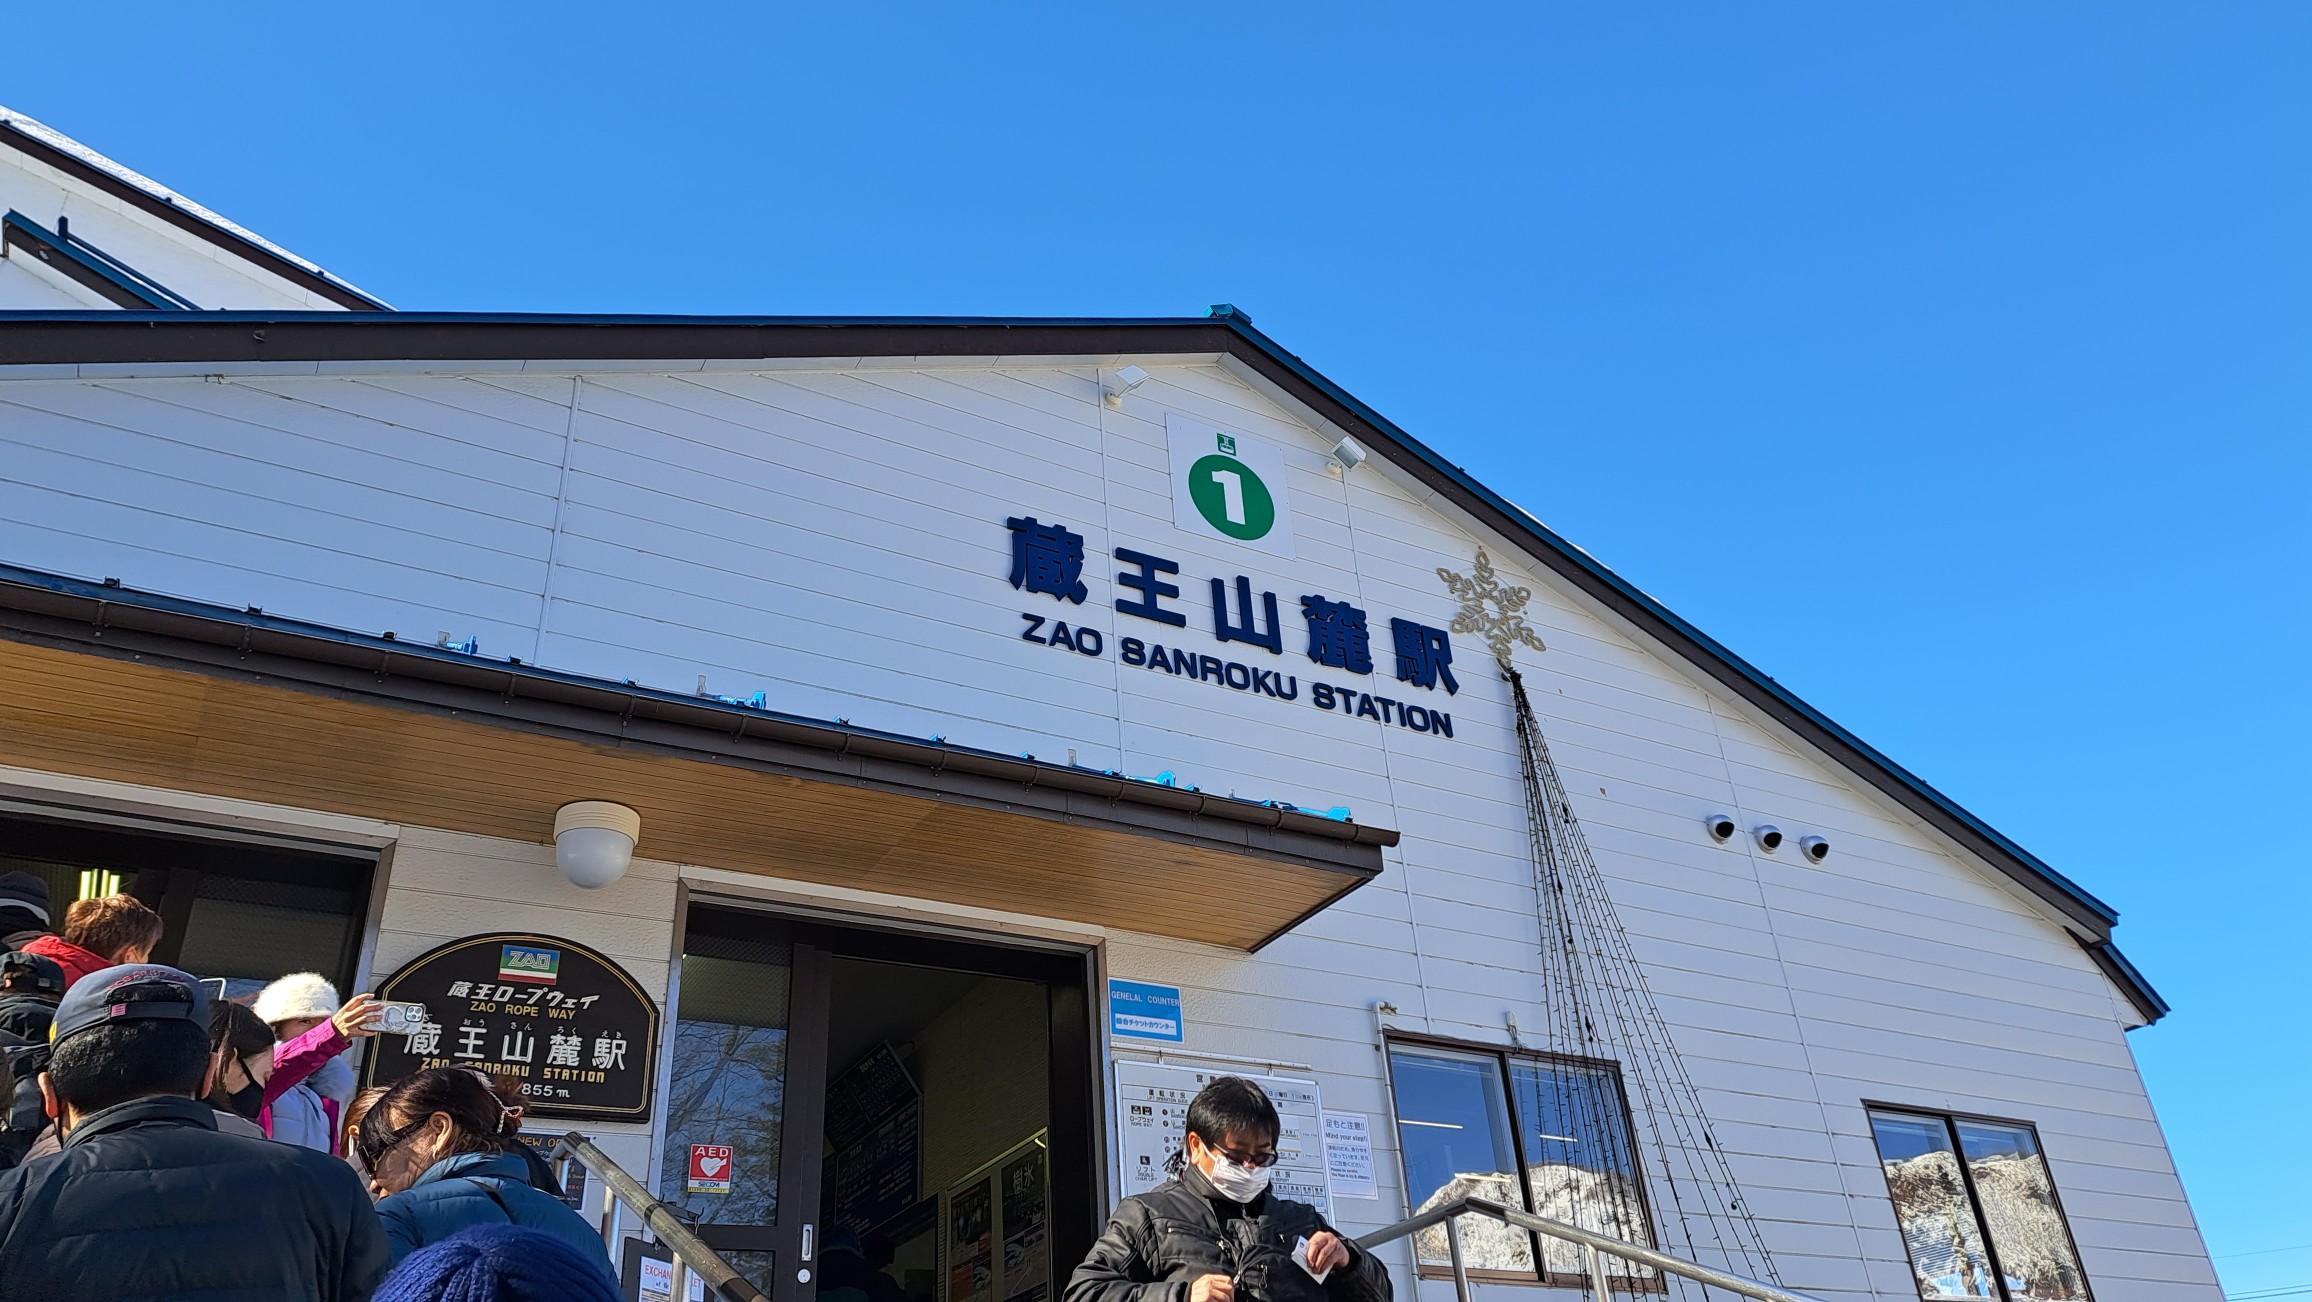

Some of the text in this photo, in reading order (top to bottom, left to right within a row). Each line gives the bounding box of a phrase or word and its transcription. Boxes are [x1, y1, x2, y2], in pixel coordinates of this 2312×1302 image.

[1211, 471, 1247, 525] 1
[1006, 515, 1459, 696] 蔵王山麓駅
[1022, 612, 1454, 738] ZAO SANROKU STATION
[507, 950, 551, 970] ZAO
[447, 980, 600, 1010] 蔵王ロープウェイ
[1111, 991, 1180, 1007] GENELAL COUNTER
[470, 1001, 576, 1020] ZAO ROPE WAY
[403, 1021, 627, 1071] 蔵王山麓駅
[422, 1057, 450, 1070] ZAO
[543, 1067, 605, 1083] STATION
[518, 1136, 542, 1147] NEW
[1340, 1134, 1352, 1142] your
[695, 1146, 729, 1157] AED
[645, 1264, 672, 1279] EXCHAN
